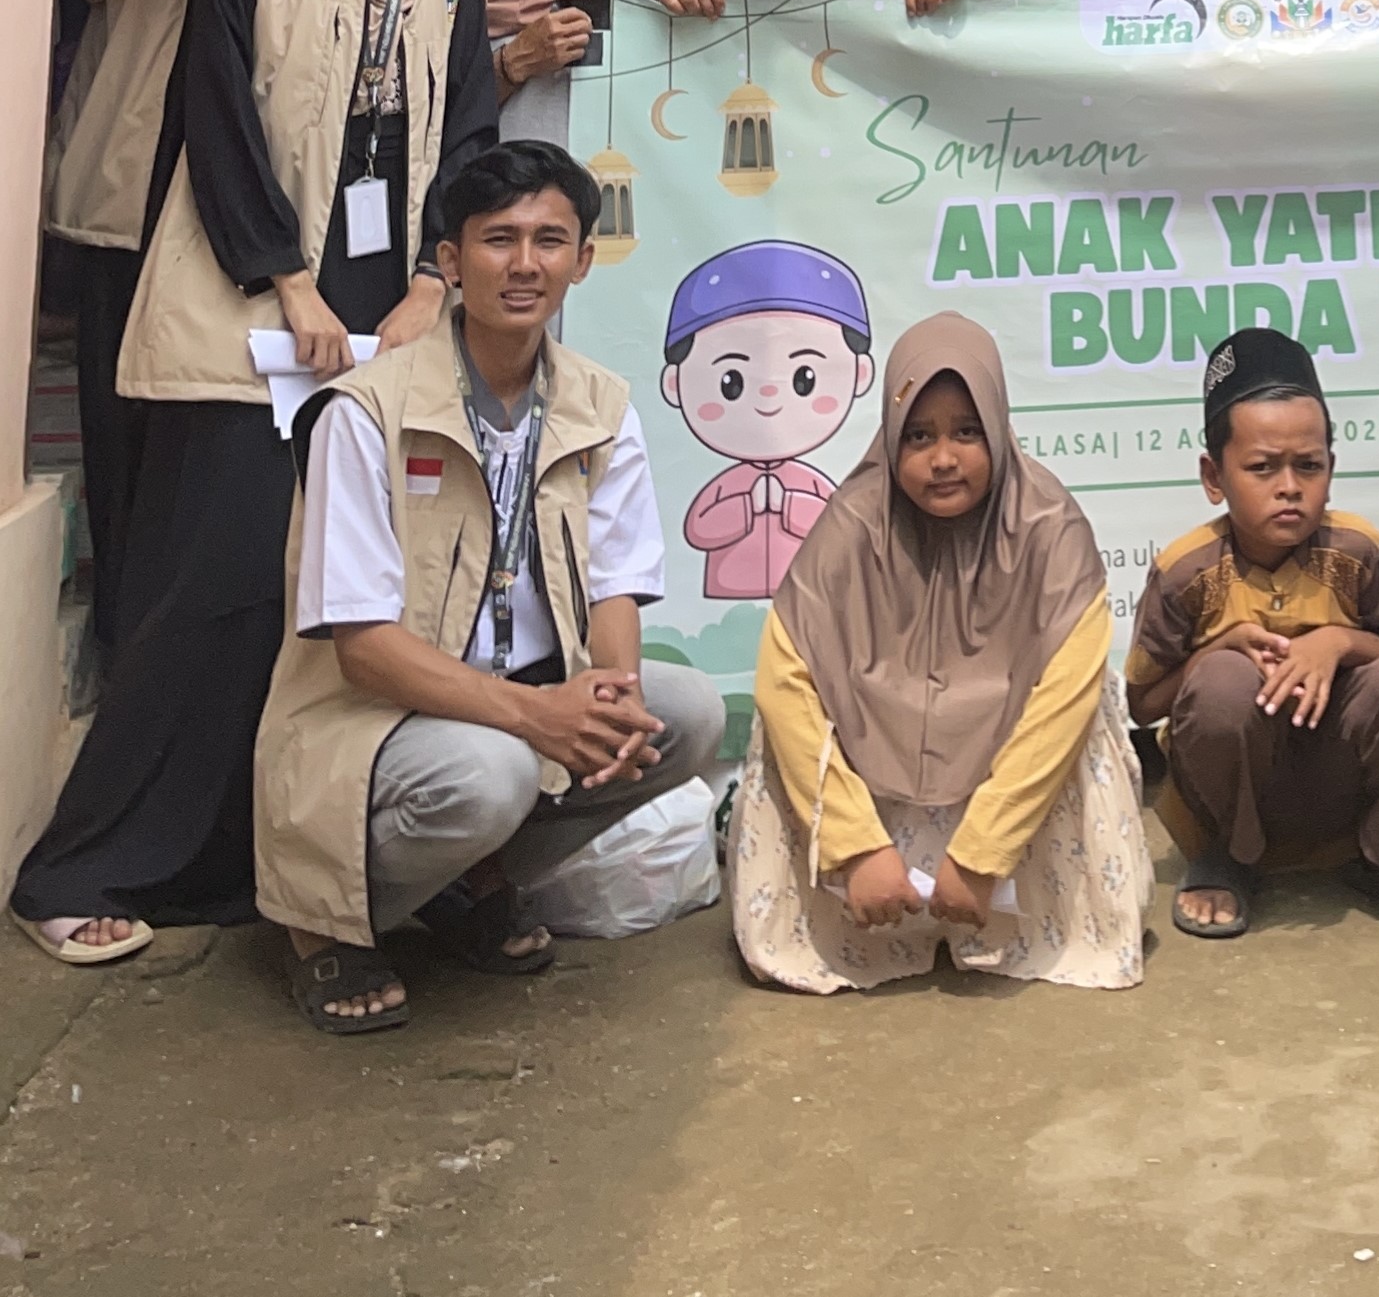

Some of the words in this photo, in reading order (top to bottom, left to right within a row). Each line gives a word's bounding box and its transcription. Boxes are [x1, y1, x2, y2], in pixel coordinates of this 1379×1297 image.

[1102, 12, 1193, 46] harfa
[866, 93, 1149, 206] Santunan
[931, 196, 1177, 281] ANAK
[1050, 278, 1357, 368] BUNDA
[1135, 429, 1163, 452] 12
